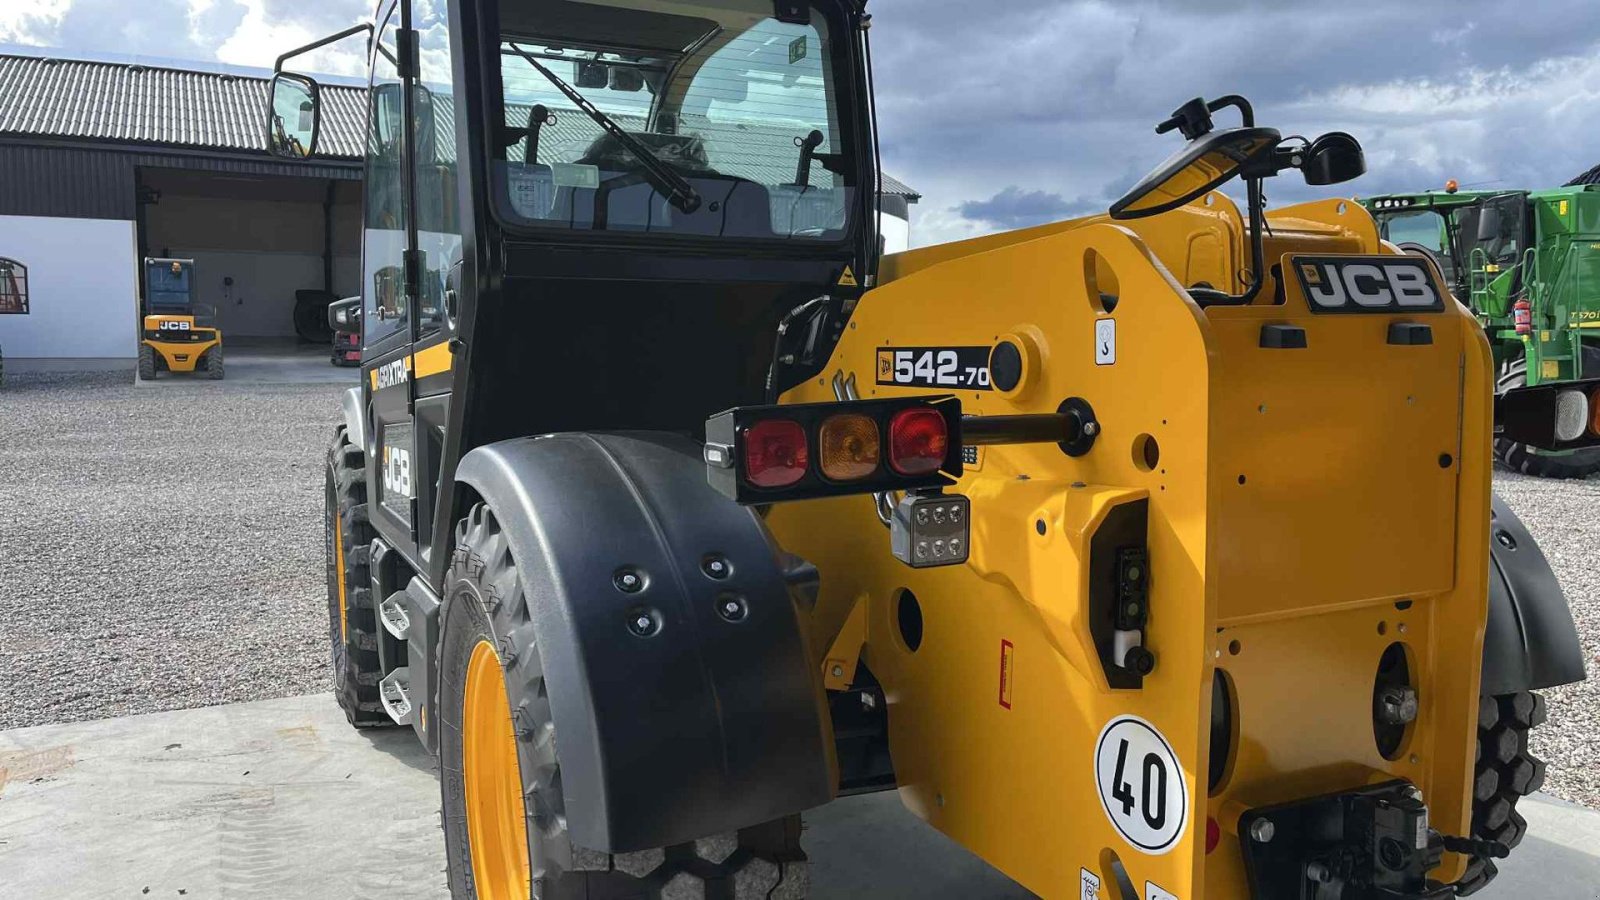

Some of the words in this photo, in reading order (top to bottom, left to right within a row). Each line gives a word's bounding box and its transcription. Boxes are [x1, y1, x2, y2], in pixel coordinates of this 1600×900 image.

[1301, 264, 1434, 307] JCB
[160, 321, 189, 330] JCB
[384, 445, 410, 497] JCB
[1112, 738, 1167, 830] 40
